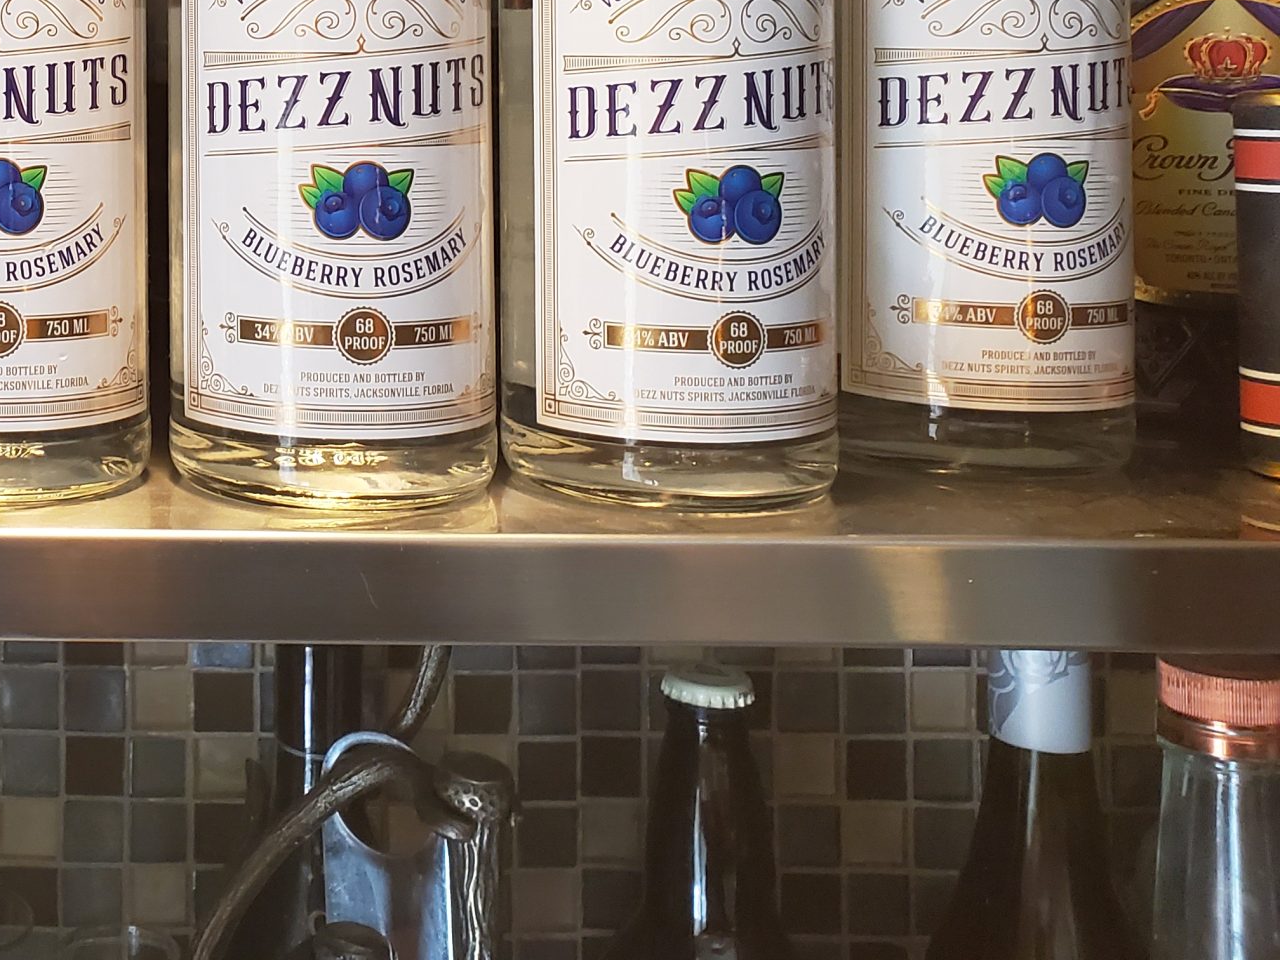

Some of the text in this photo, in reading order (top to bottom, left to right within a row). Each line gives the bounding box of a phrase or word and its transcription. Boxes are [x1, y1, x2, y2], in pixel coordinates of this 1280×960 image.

[2, 53, 128, 125] NUTS
[207, 54, 484, 134] DEZZ NUTS
[878, 68, 1036, 127] DEZZ
[568, 74, 727, 140] DEZZ
[1133, 134, 1218, 181] Crown
[919, 215, 1126, 272] BLUEBERRY ROSEMARY
[6, 223, 105, 282] ROSEMARY
[241, 227, 467, 288] BLUEBERRY ROSEMARY
[609, 231, 826, 292] BLUEBERRY ROSEMARY
[1037, 300, 1053, 315] 68
[966, 308, 996, 323] ABV
[1087, 309, 1105, 323] 750
[46, 318, 91, 336] 750 ML
[254, 323, 280, 340] 34%
[355, 318, 374, 334] 68
[730, 321, 748, 337] 68
[1025, 317, 1064, 331] PROOF
[414, 325, 455, 342] 750 ML
[625, 330, 689, 348] 4% ABV
[783, 330, 802, 345] 750
[344, 336, 386, 351] PROOF
[720, 340, 759, 354] PROOF
[982, 350, 1031, 360] PRODUCE
[1033, 352, 1051, 360] AND
[1053, 351, 1086, 361] BOTTLED
[6, 365, 45, 376] BOTTLED
[47, 364, 58, 375] BY
[967, 363, 992, 373] NUTS
[55, 376, 89, 389] FLORIDA
[300, 371, 425, 383] PRODUCED AND BOTTLED BY
[674, 373, 793, 387] PRODUCED AND BOTTLED BY
[264, 383, 280, 394] DEZ
[422, 383, 454, 395] FLORIDA
[660, 390, 685, 401] NUTS
